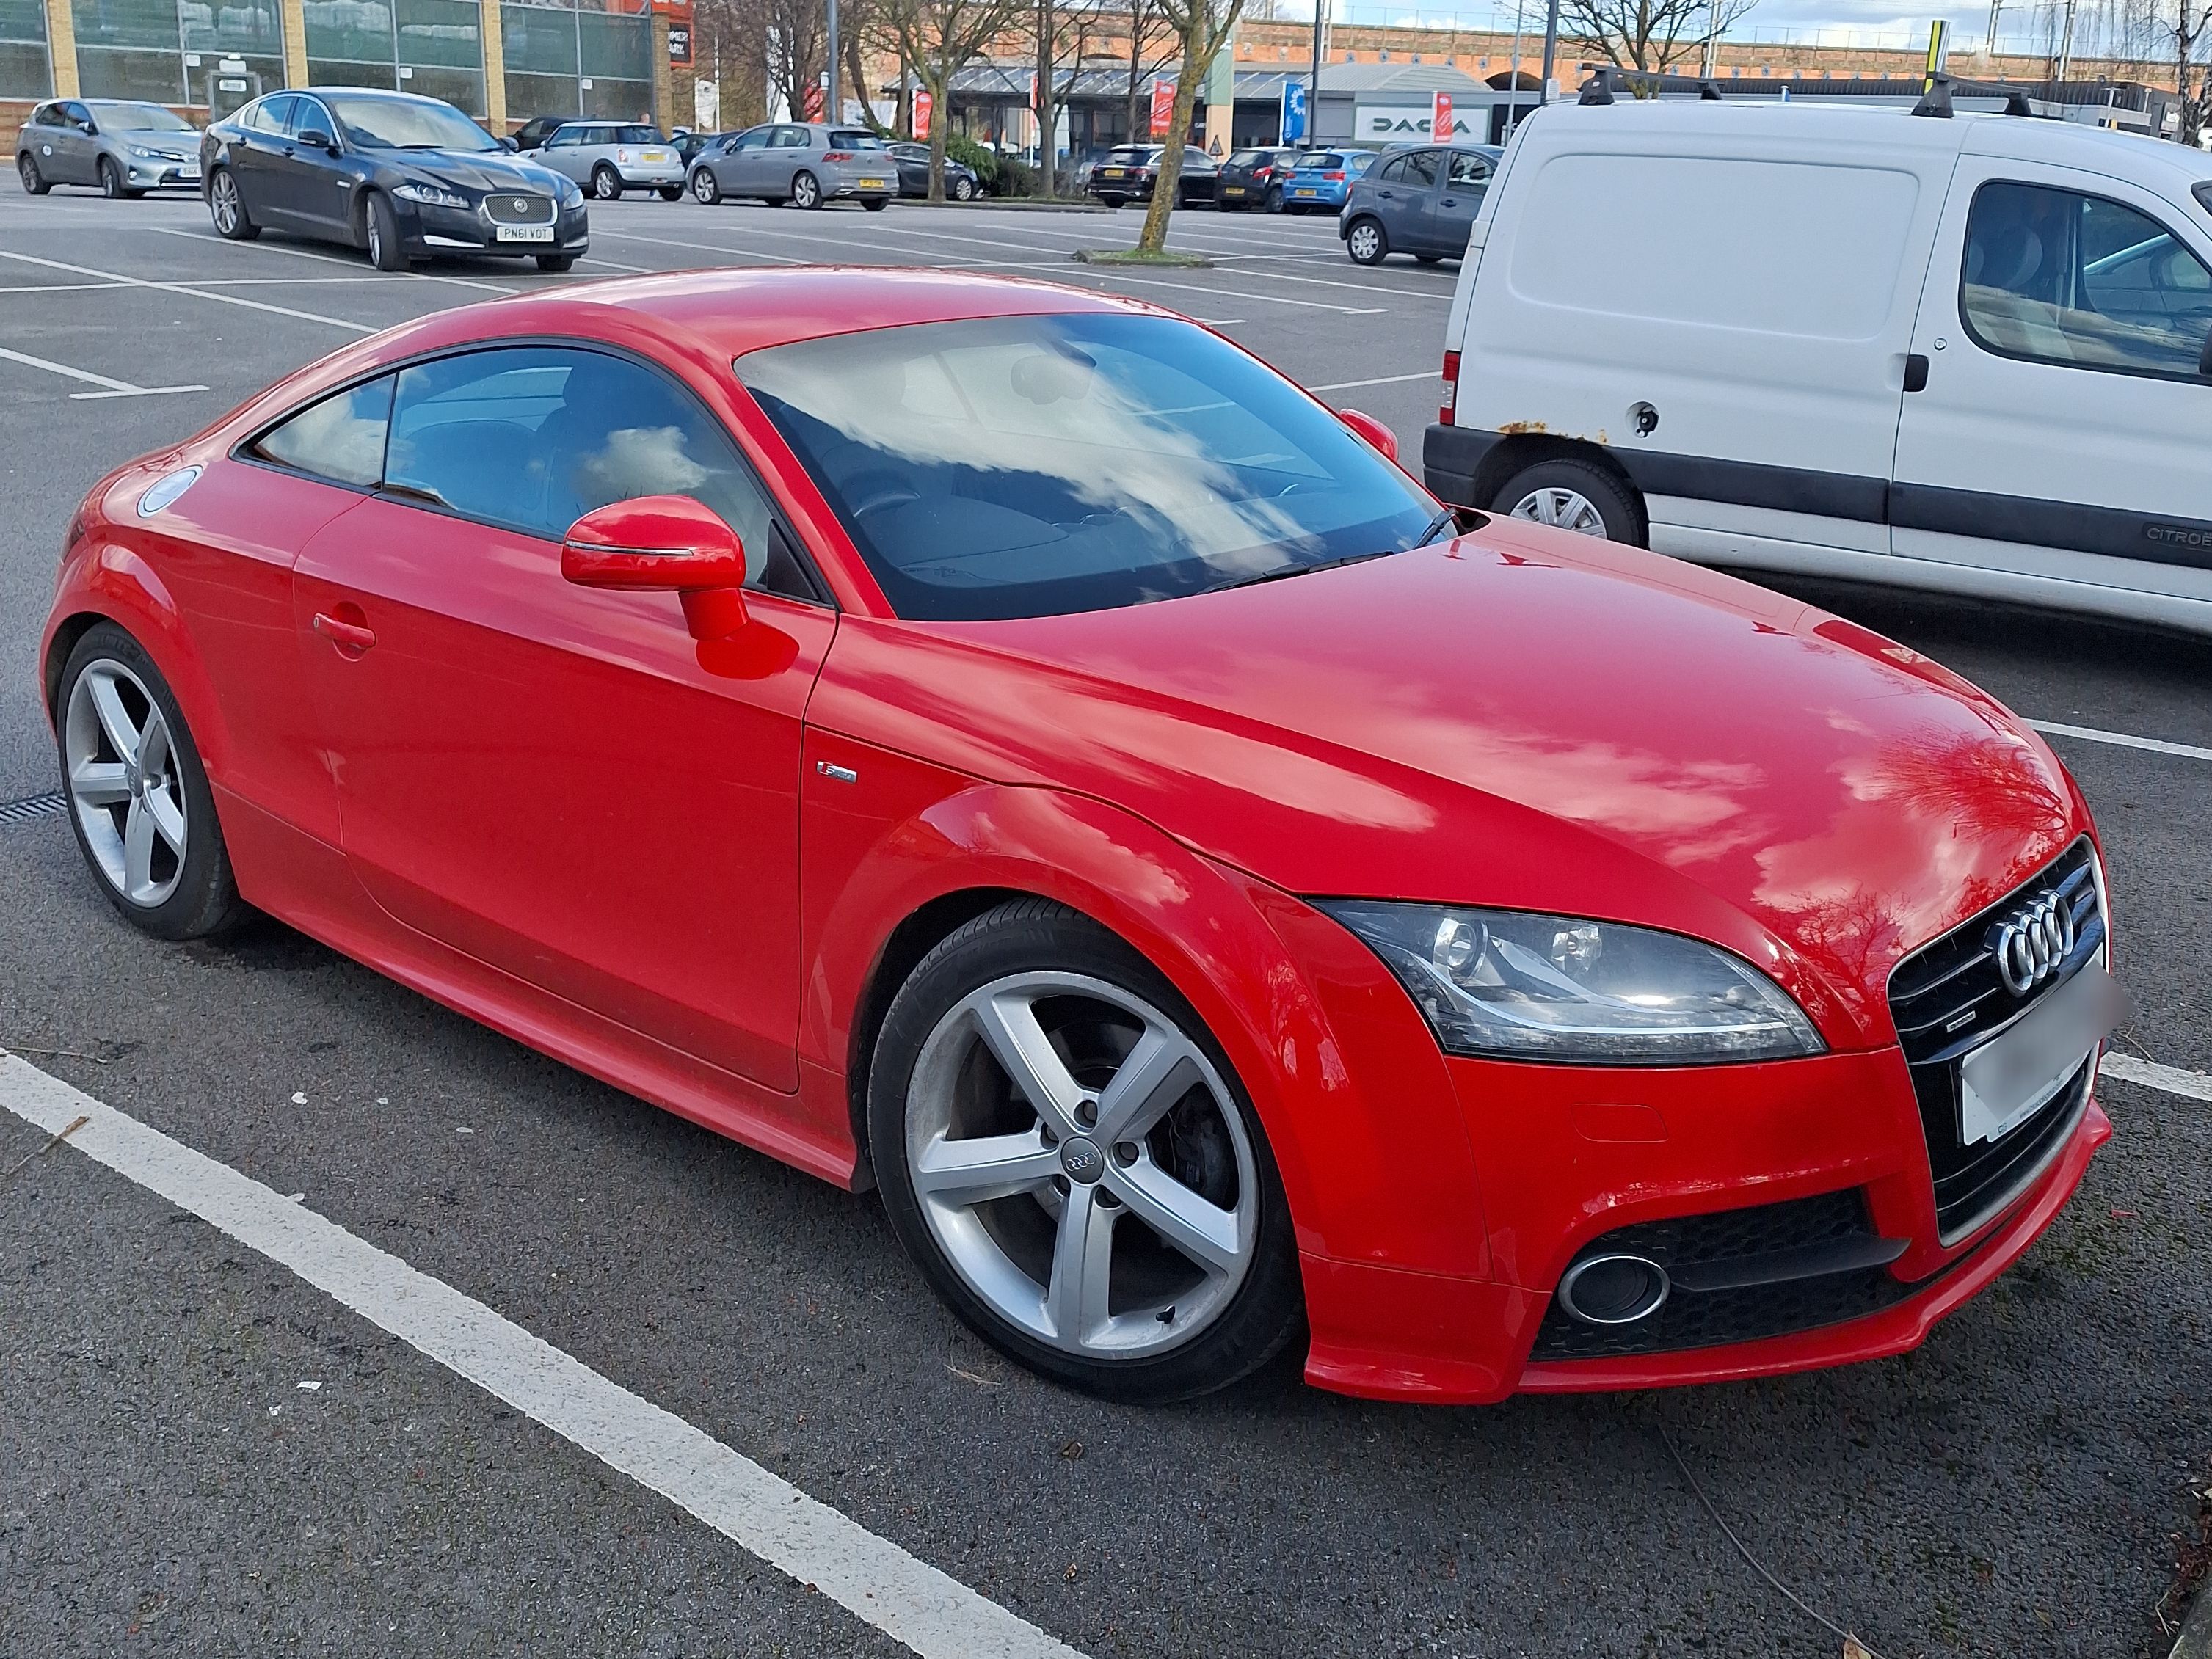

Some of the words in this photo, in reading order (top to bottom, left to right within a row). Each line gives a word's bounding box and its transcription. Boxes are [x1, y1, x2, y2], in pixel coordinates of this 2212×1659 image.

[1373, 117, 1471, 134] DACA
[505, 228, 527, 239] PN61
[530, 228, 547, 239] VOT
